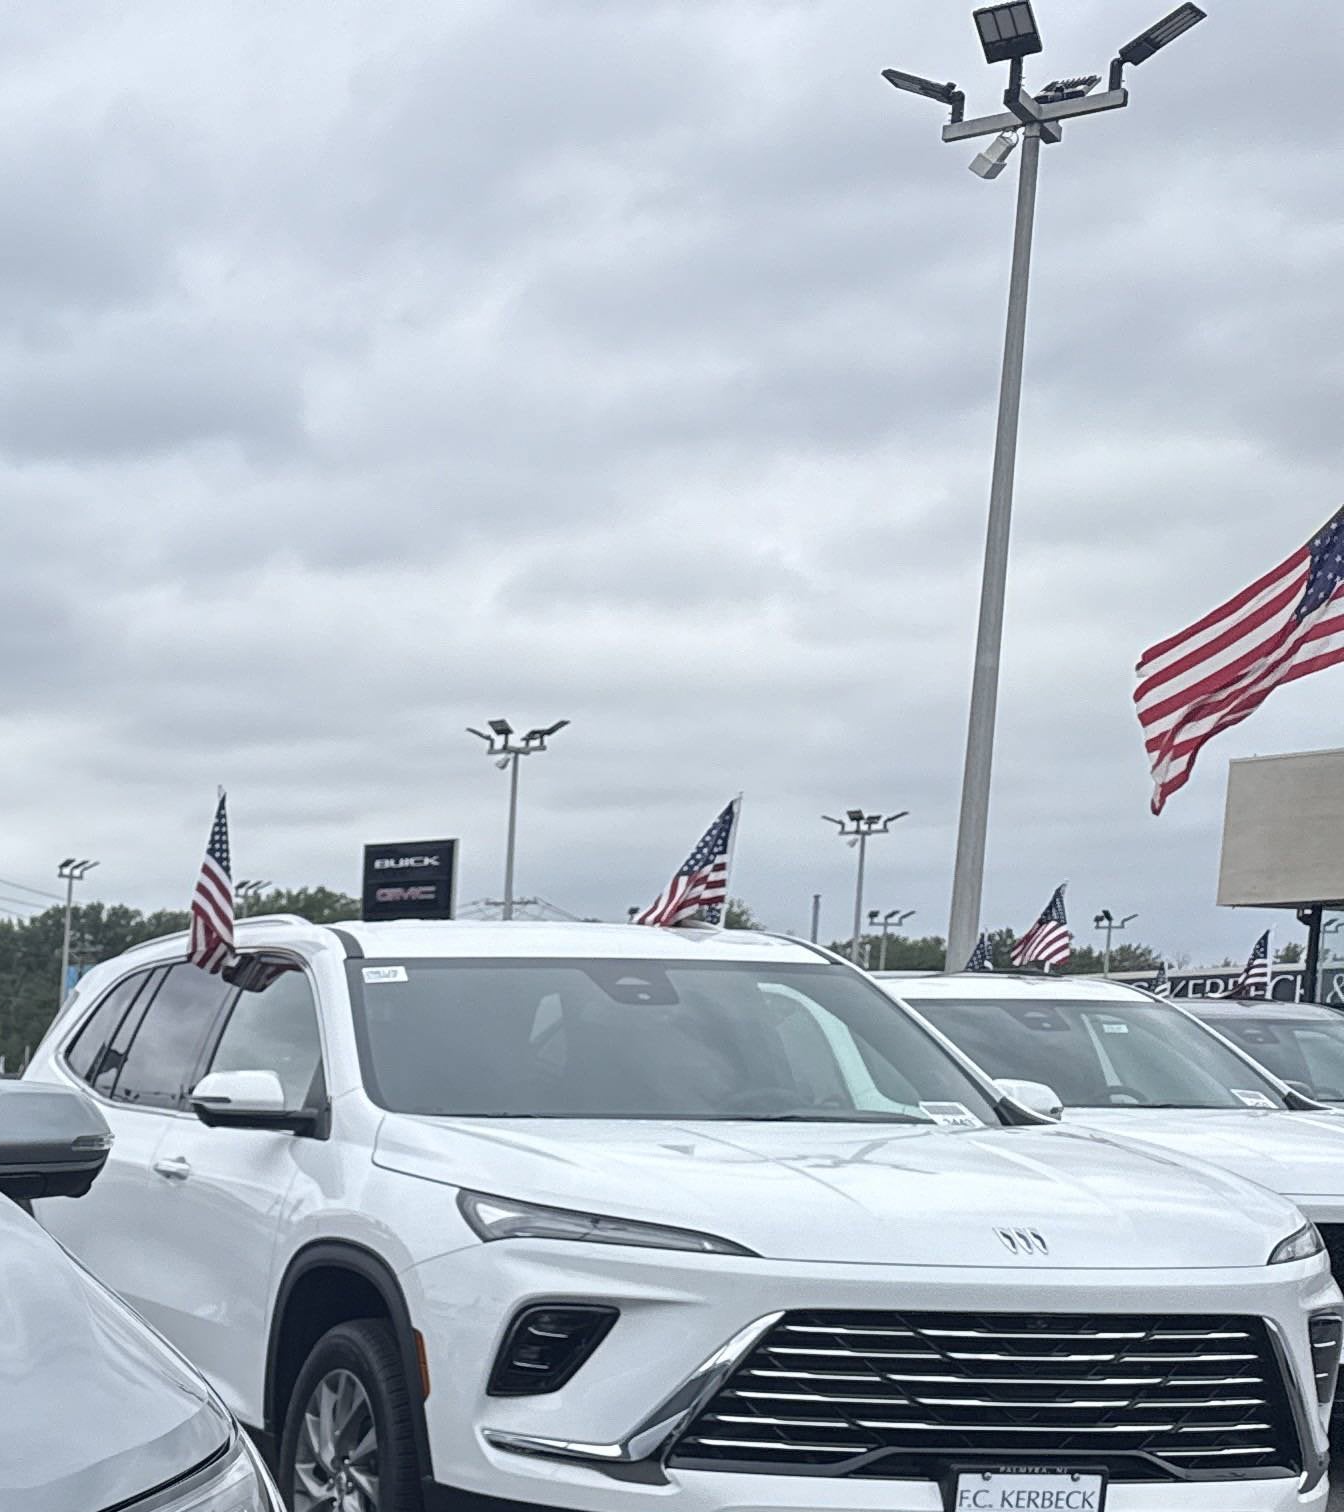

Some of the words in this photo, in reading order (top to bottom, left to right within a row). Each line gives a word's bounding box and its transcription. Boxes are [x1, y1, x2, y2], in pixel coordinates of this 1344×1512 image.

[374, 856, 440, 869] BUICK
[376, 886, 436, 902] GMC
[959, 1489, 992, 1508] F.C.
[1000, 1490, 1095, 1509] KERBECK
